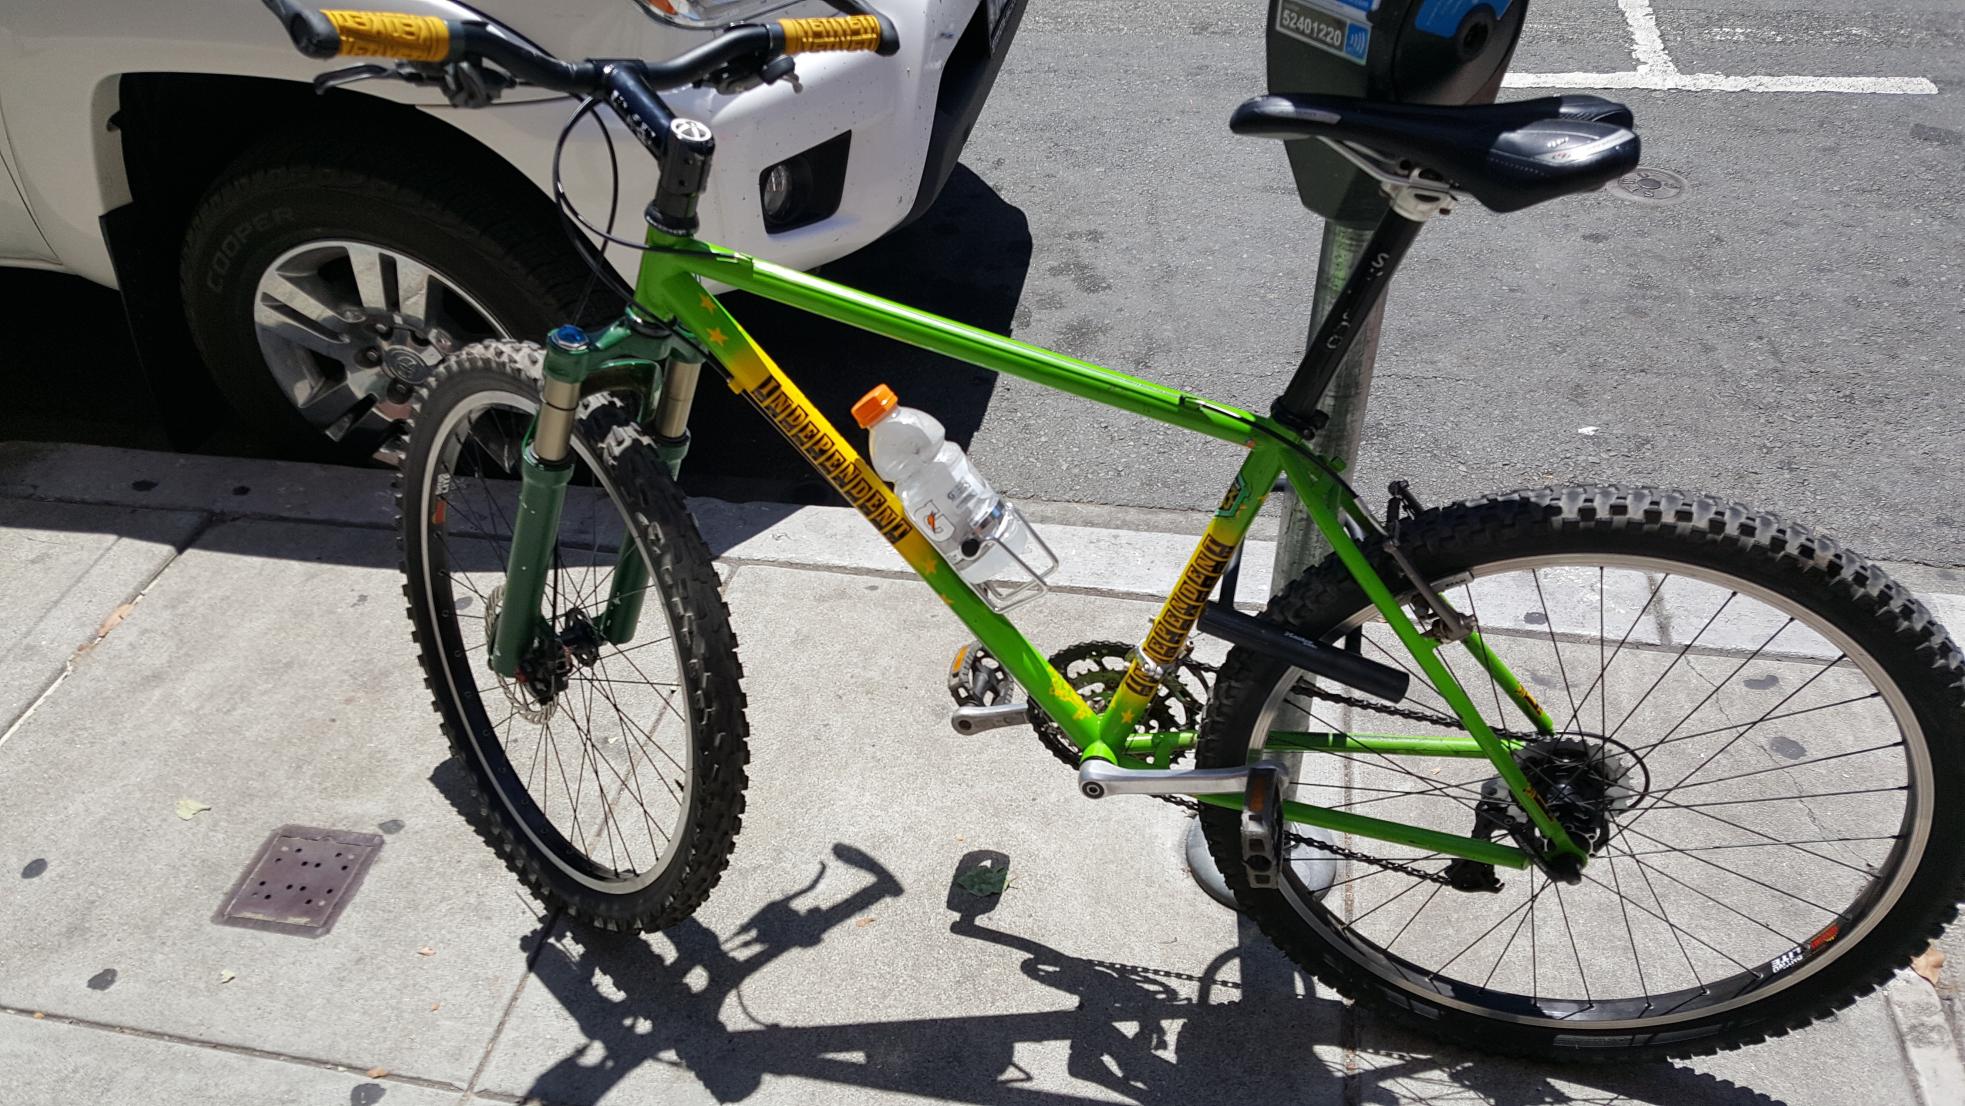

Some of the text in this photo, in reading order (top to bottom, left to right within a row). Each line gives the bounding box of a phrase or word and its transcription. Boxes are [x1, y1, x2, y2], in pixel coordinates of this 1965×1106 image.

[1282, 9, 1342, 46] 52401220
[206, 206, 296, 293] COOPER
[752, 375, 913, 544] INDEPENDENT
[1126, 533, 1235, 697] INEPENDENT
